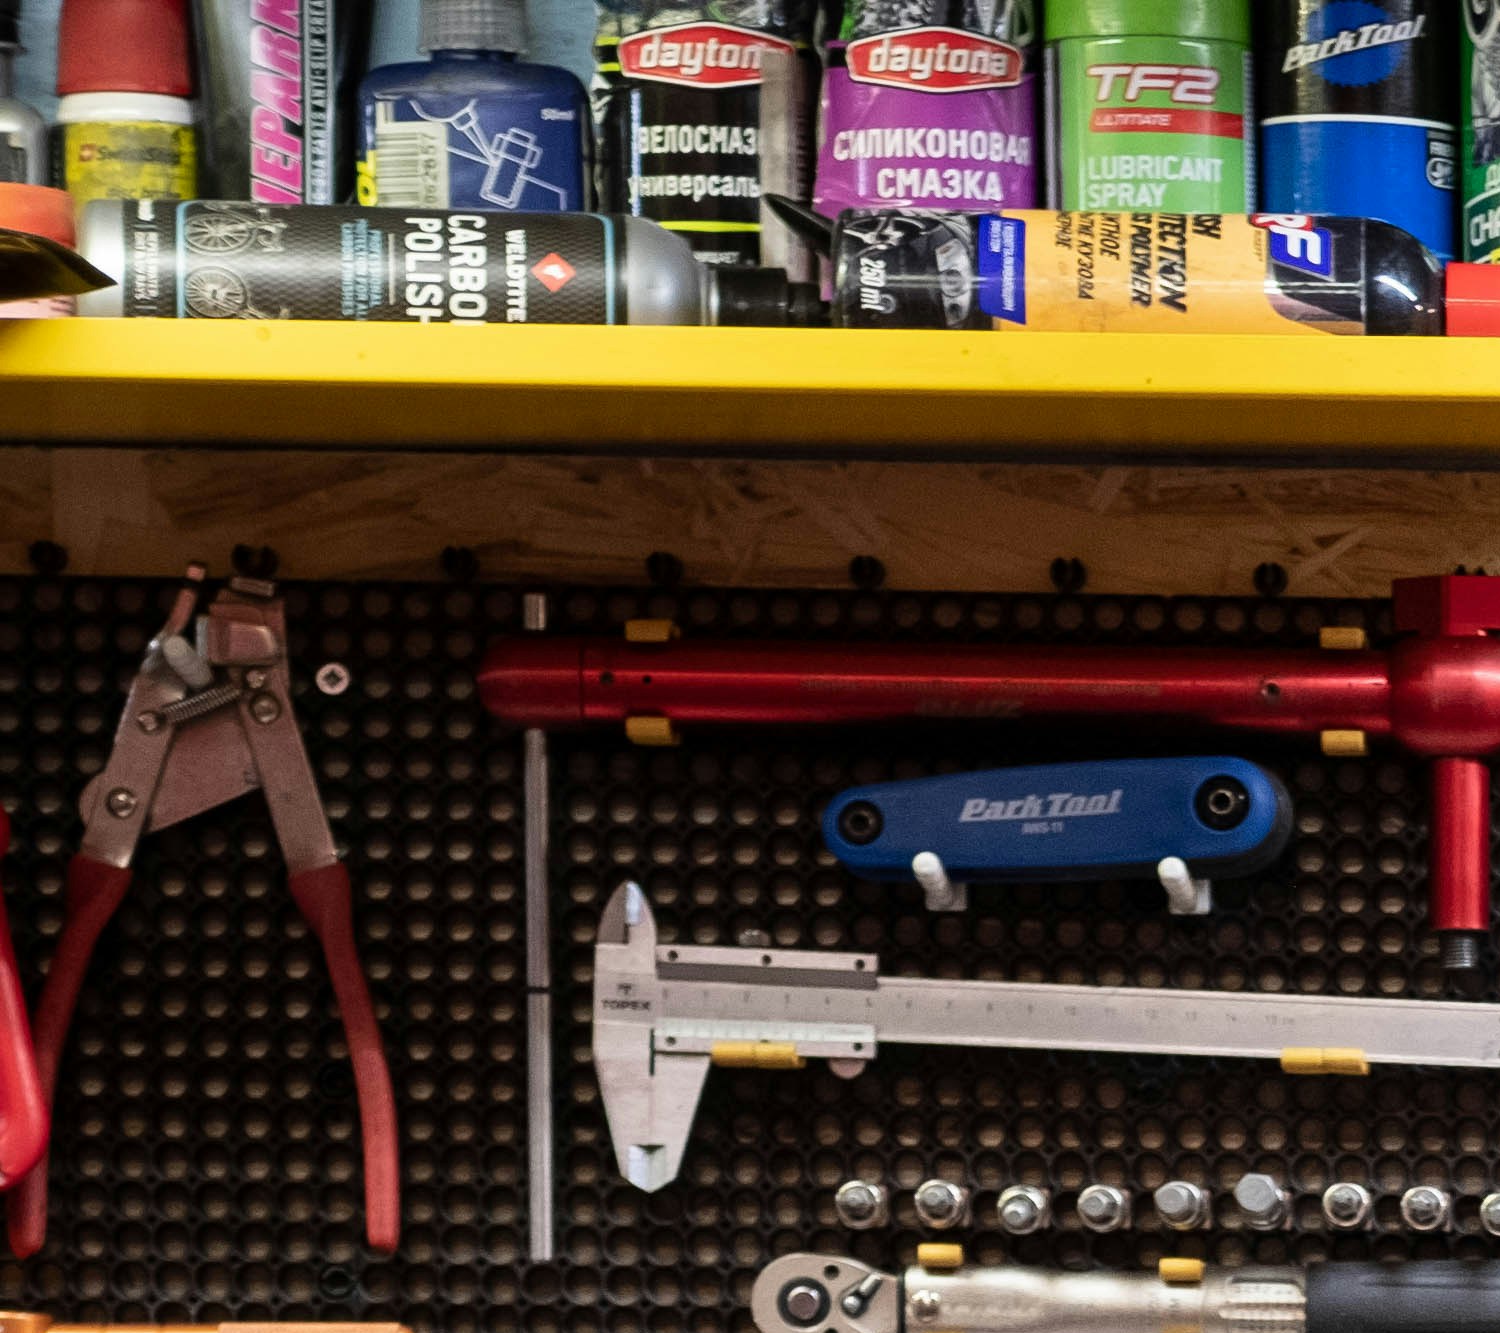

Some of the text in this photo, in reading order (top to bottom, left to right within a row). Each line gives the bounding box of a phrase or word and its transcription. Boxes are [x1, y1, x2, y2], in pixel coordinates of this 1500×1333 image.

[639, 35, 762, 76] dayton
[866, 38, 1011, 80] daytona
[1086, 64, 1222, 106] TF2
[637, 124, 758, 154] ВЕЛОСМАЗ
[833, 127, 1034, 168] СИЛИКОНОВАЯ
[628, 174, 761, 203] универсаль
[876, 167, 1005, 202] СМАЗКА
[1086, 155, 1223, 183] LUBRICANT
[1085, 183, 1166, 210] SPRAY
[447, 214, 488, 327] CARBO
[1157, 214, 1188, 313] TECTION
